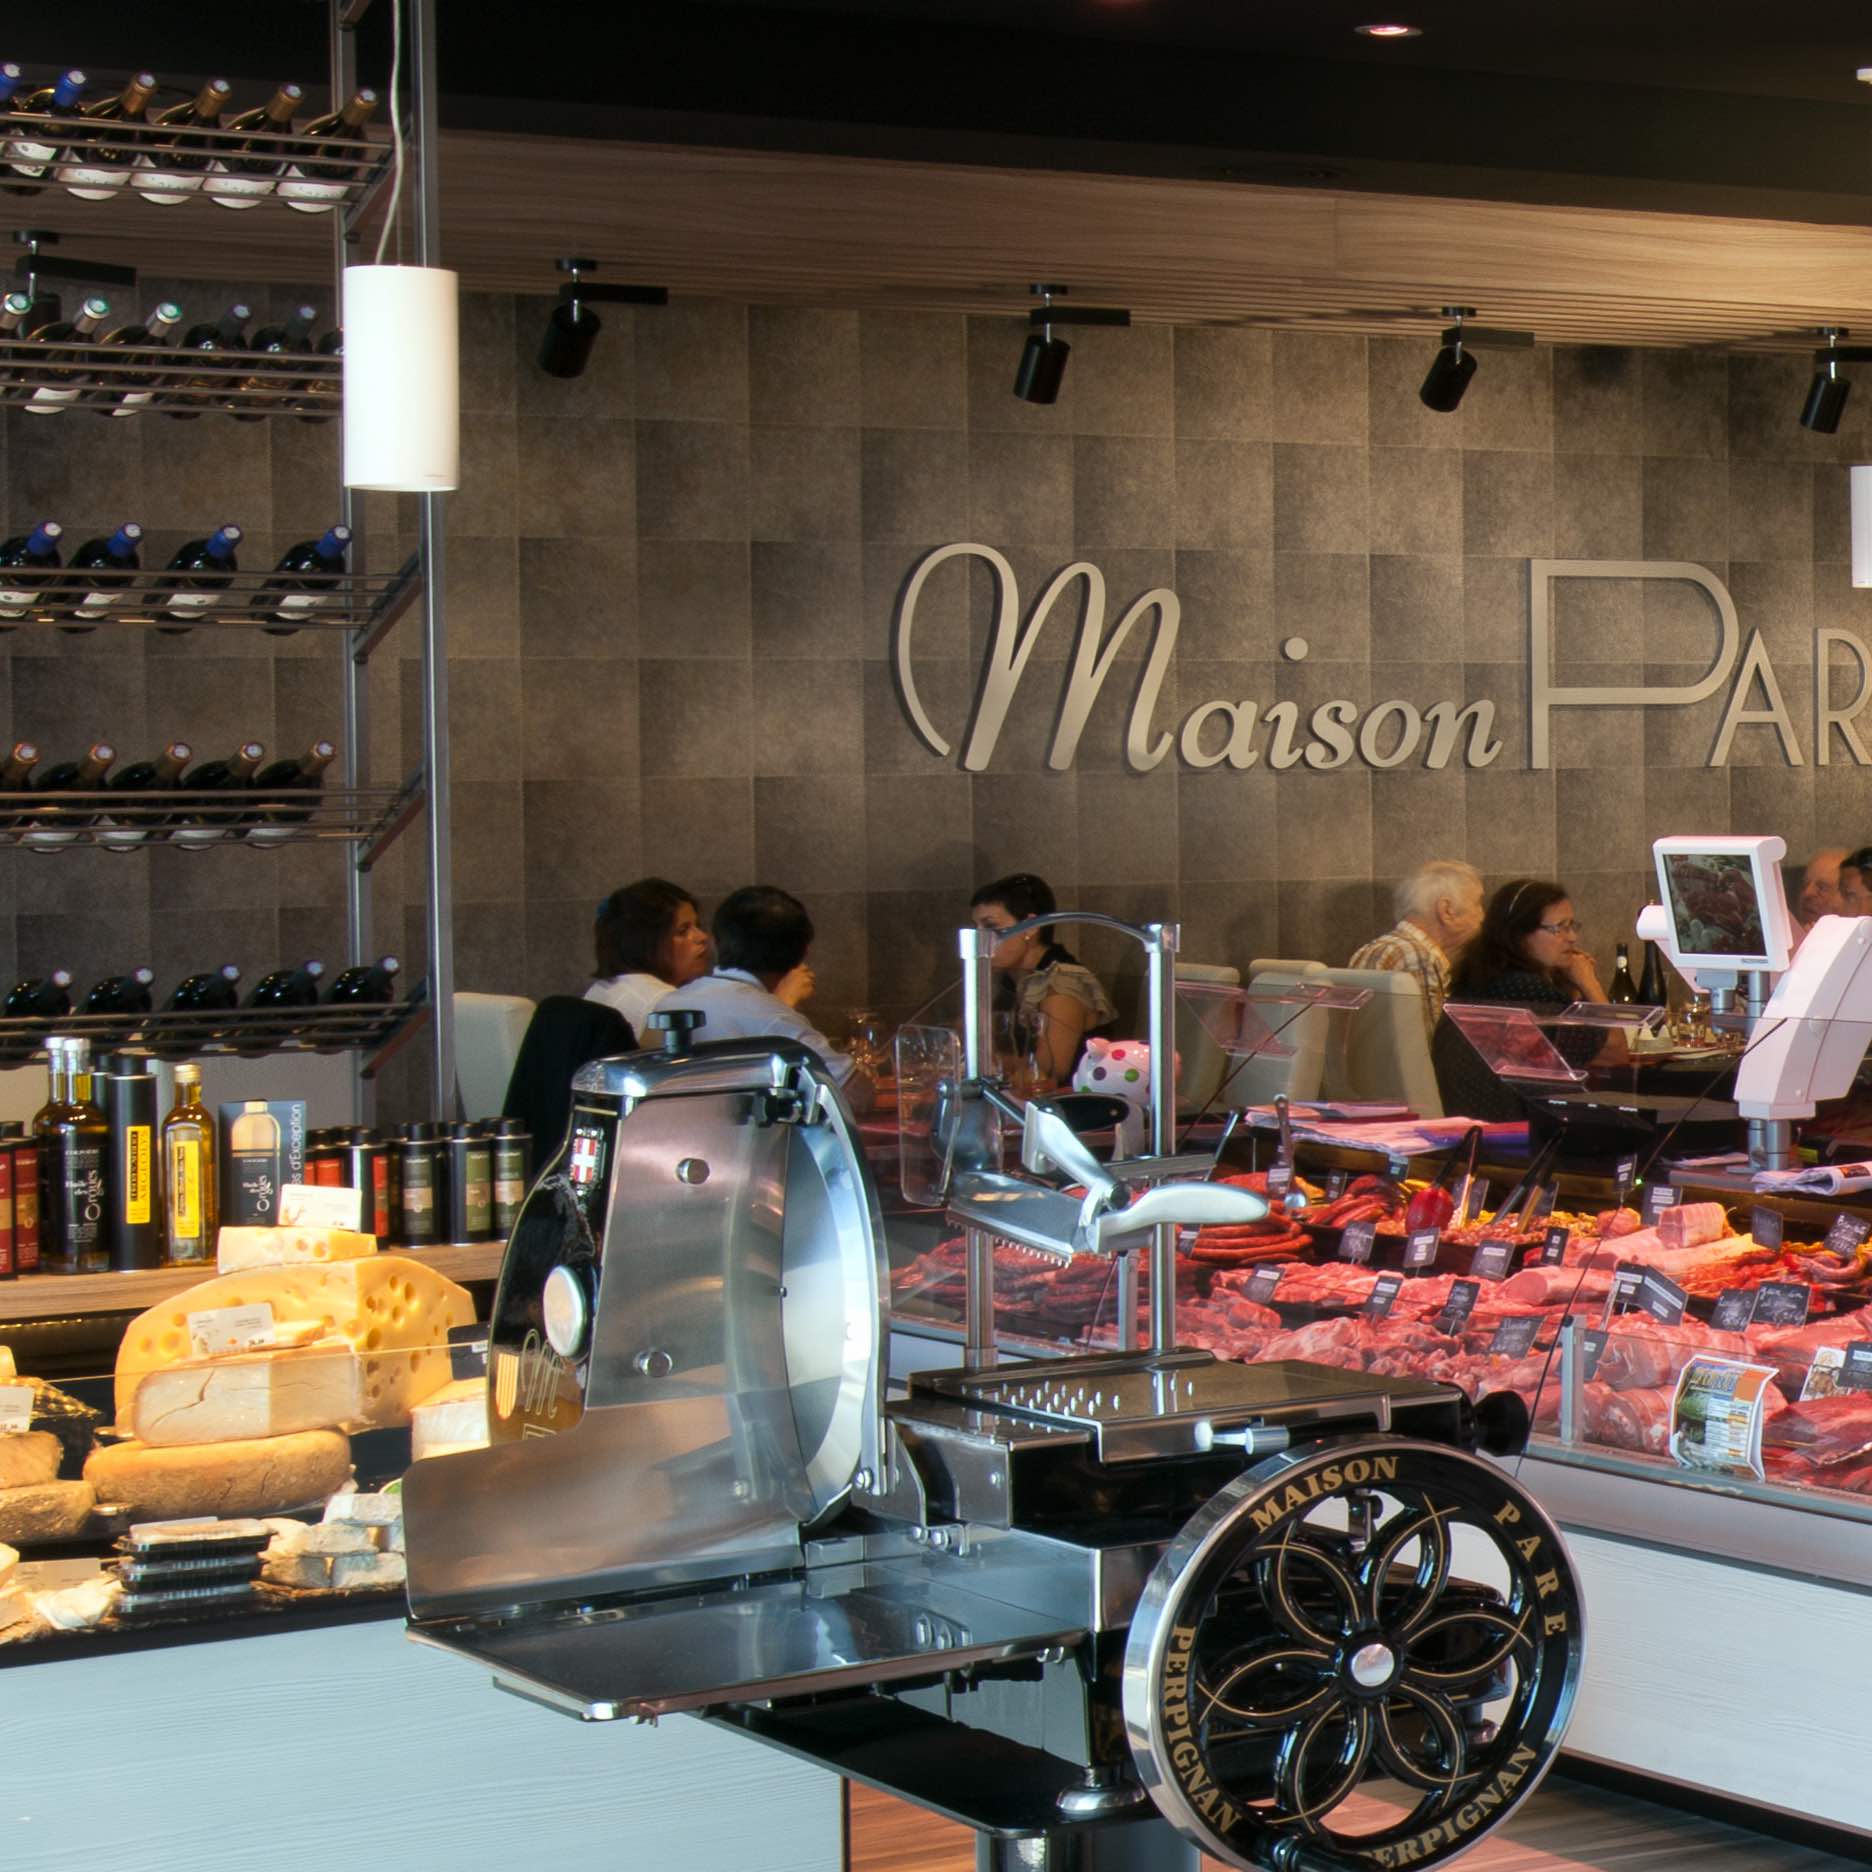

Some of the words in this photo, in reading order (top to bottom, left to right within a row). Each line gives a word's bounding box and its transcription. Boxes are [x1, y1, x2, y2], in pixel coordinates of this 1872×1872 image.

[896, 542, 1502, 773] Maison
[1250, 1456, 1402, 1535] MAISON
[1492, 1500, 1568, 1637] PARE
[1163, 1625, 1244, 1836] PERPIGNAN
